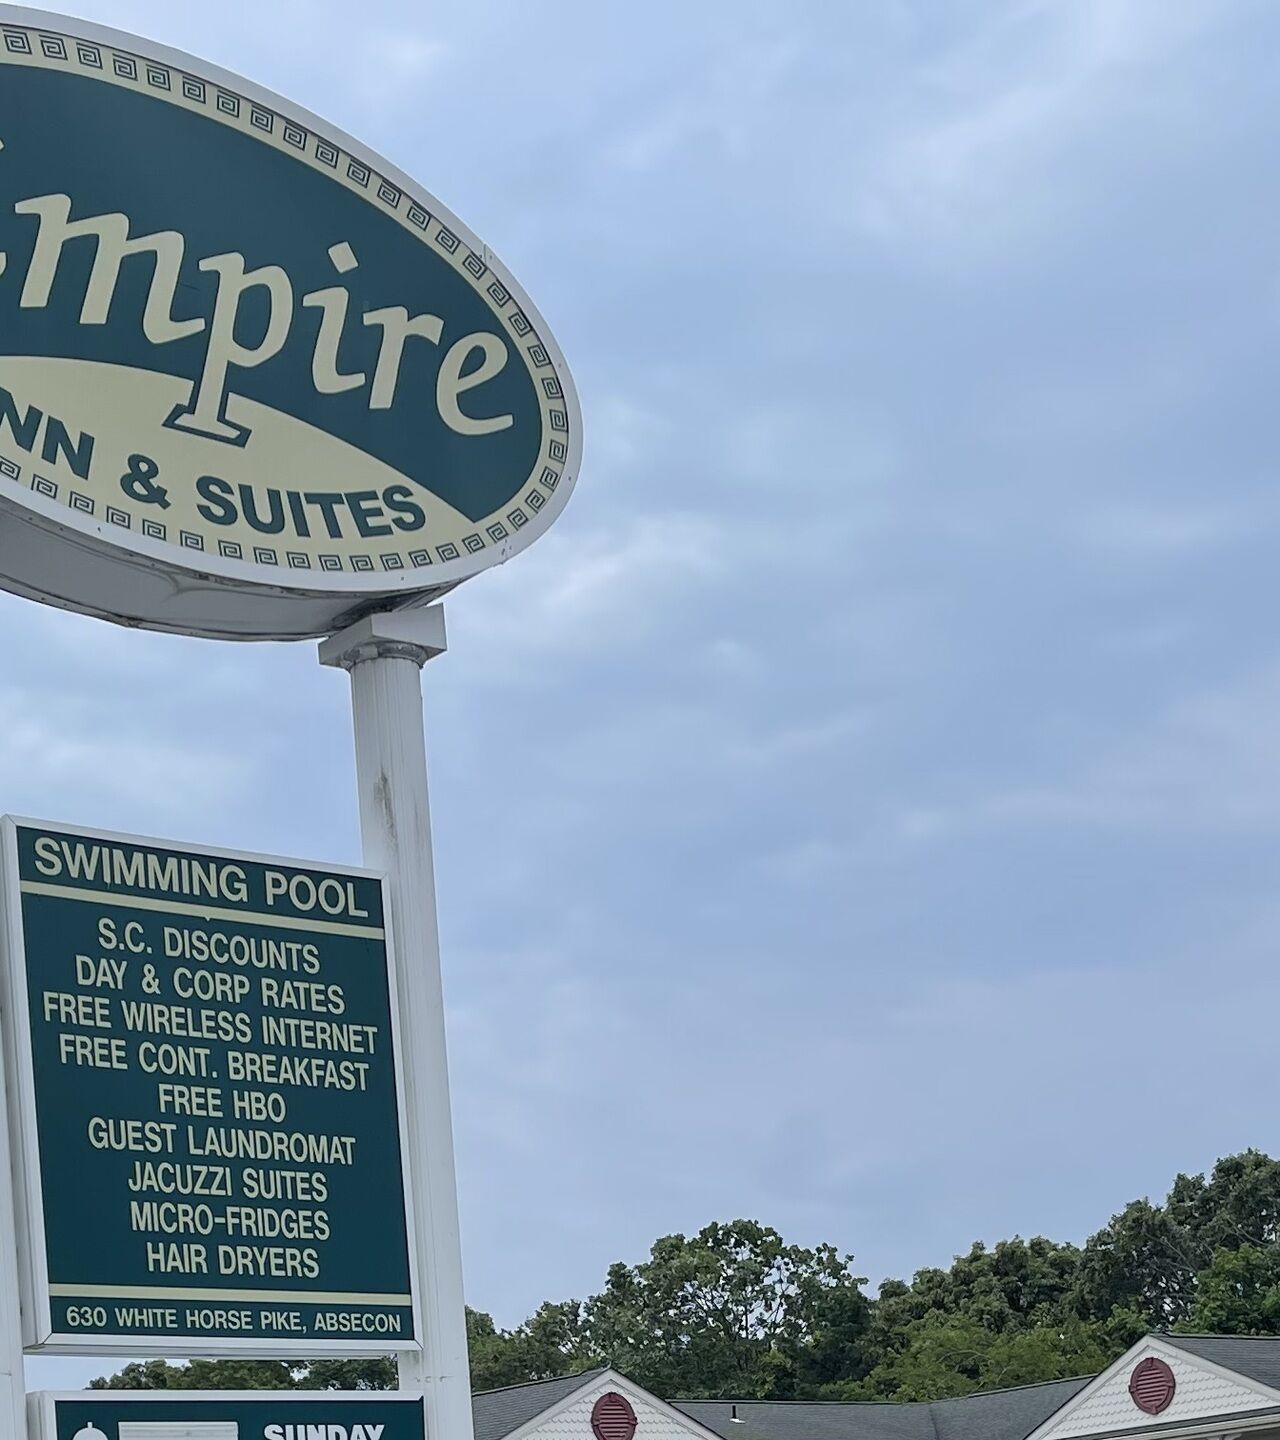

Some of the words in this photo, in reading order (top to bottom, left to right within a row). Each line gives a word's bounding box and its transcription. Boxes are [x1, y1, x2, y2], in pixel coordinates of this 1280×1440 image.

[120, 454, 171, 510] &
[196, 476, 425, 538] SUITES
[35, 838, 247, 902] SWIMMING
[265, 875, 368, 917] POOL
[99, 918, 152, 953] S.C.
[164, 927, 319, 974] DISCOUNTS
[76, 955, 127, 989] DAY
[142, 964, 161, 994] &
[174, 968, 249, 1003] CORP
[262, 978, 344, 1014] RATES
[44, 992, 111, 1028] FREE
[121, 1001, 251, 1042] WIRELESS
[262, 1016, 377, 1053] INTERNET
[60, 1034, 127, 1069] FREE
[139, 1042, 217, 1078] CONT.
[228, 1051, 369, 1090] BREAKFAST
[159, 1084, 223, 1117] FREE
[233, 1091, 286, 1122] HBO
[89, 1117, 176, 1152] GUEST
[188, 1126, 355, 1164] LAUNDROMAT
[128, 1162, 232, 1196] JACUZZI
[243, 1169, 328, 1202] SUITES
[131, 1202, 330, 1240] MICRO-FRIDGES
[147, 1243, 208, 1274] HAIR
[219, 1248, 320, 1278] DRYERS
[67, 1307, 106, 1326] 630
[115, 1308, 178, 1327] WHITE
[186, 1310, 253, 1330] HORSE
[261, 1312, 306, 1333] PIKE,
[315, 1313, 400, 1332] ABSECON
